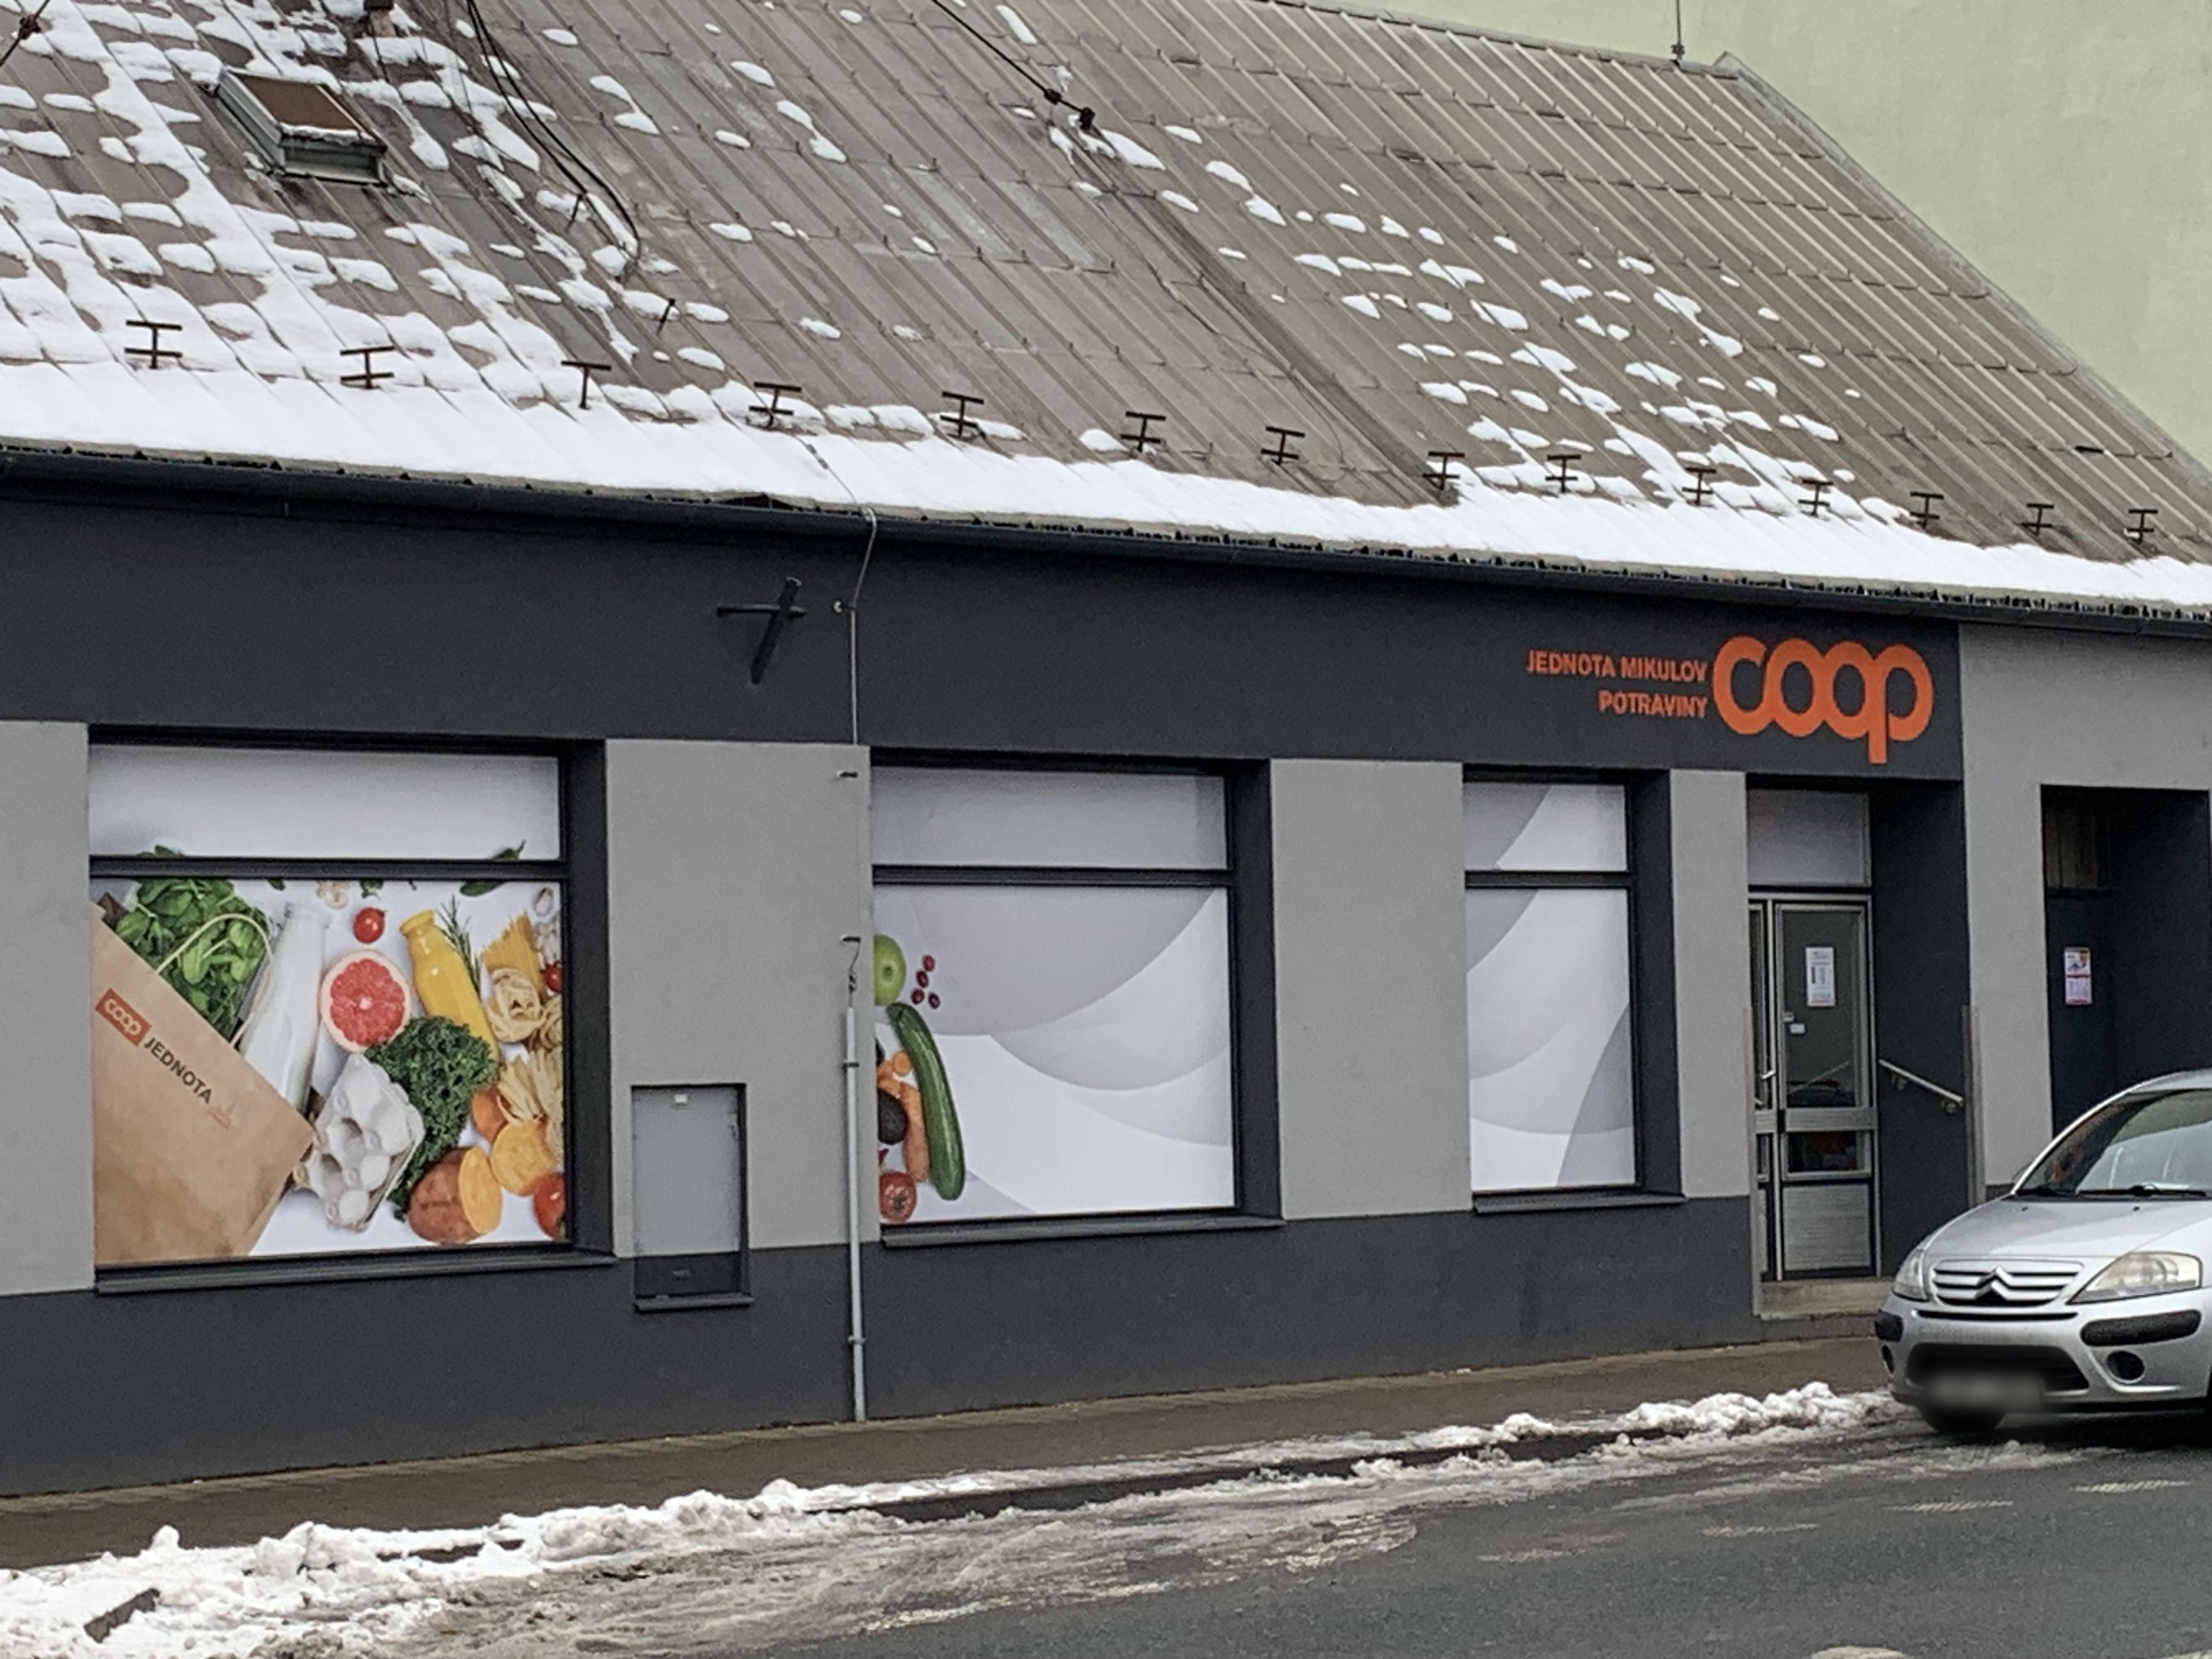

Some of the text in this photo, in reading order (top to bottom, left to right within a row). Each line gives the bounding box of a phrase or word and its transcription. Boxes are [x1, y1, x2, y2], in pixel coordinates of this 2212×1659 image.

[1526, 649, 1708, 684] JEDNOTA MIKULOV
[1599, 690, 1708, 718] POTRAVINY
[1713, 635, 1934, 764] coop
[144, 1036, 212, 1105] JEDNOTA
